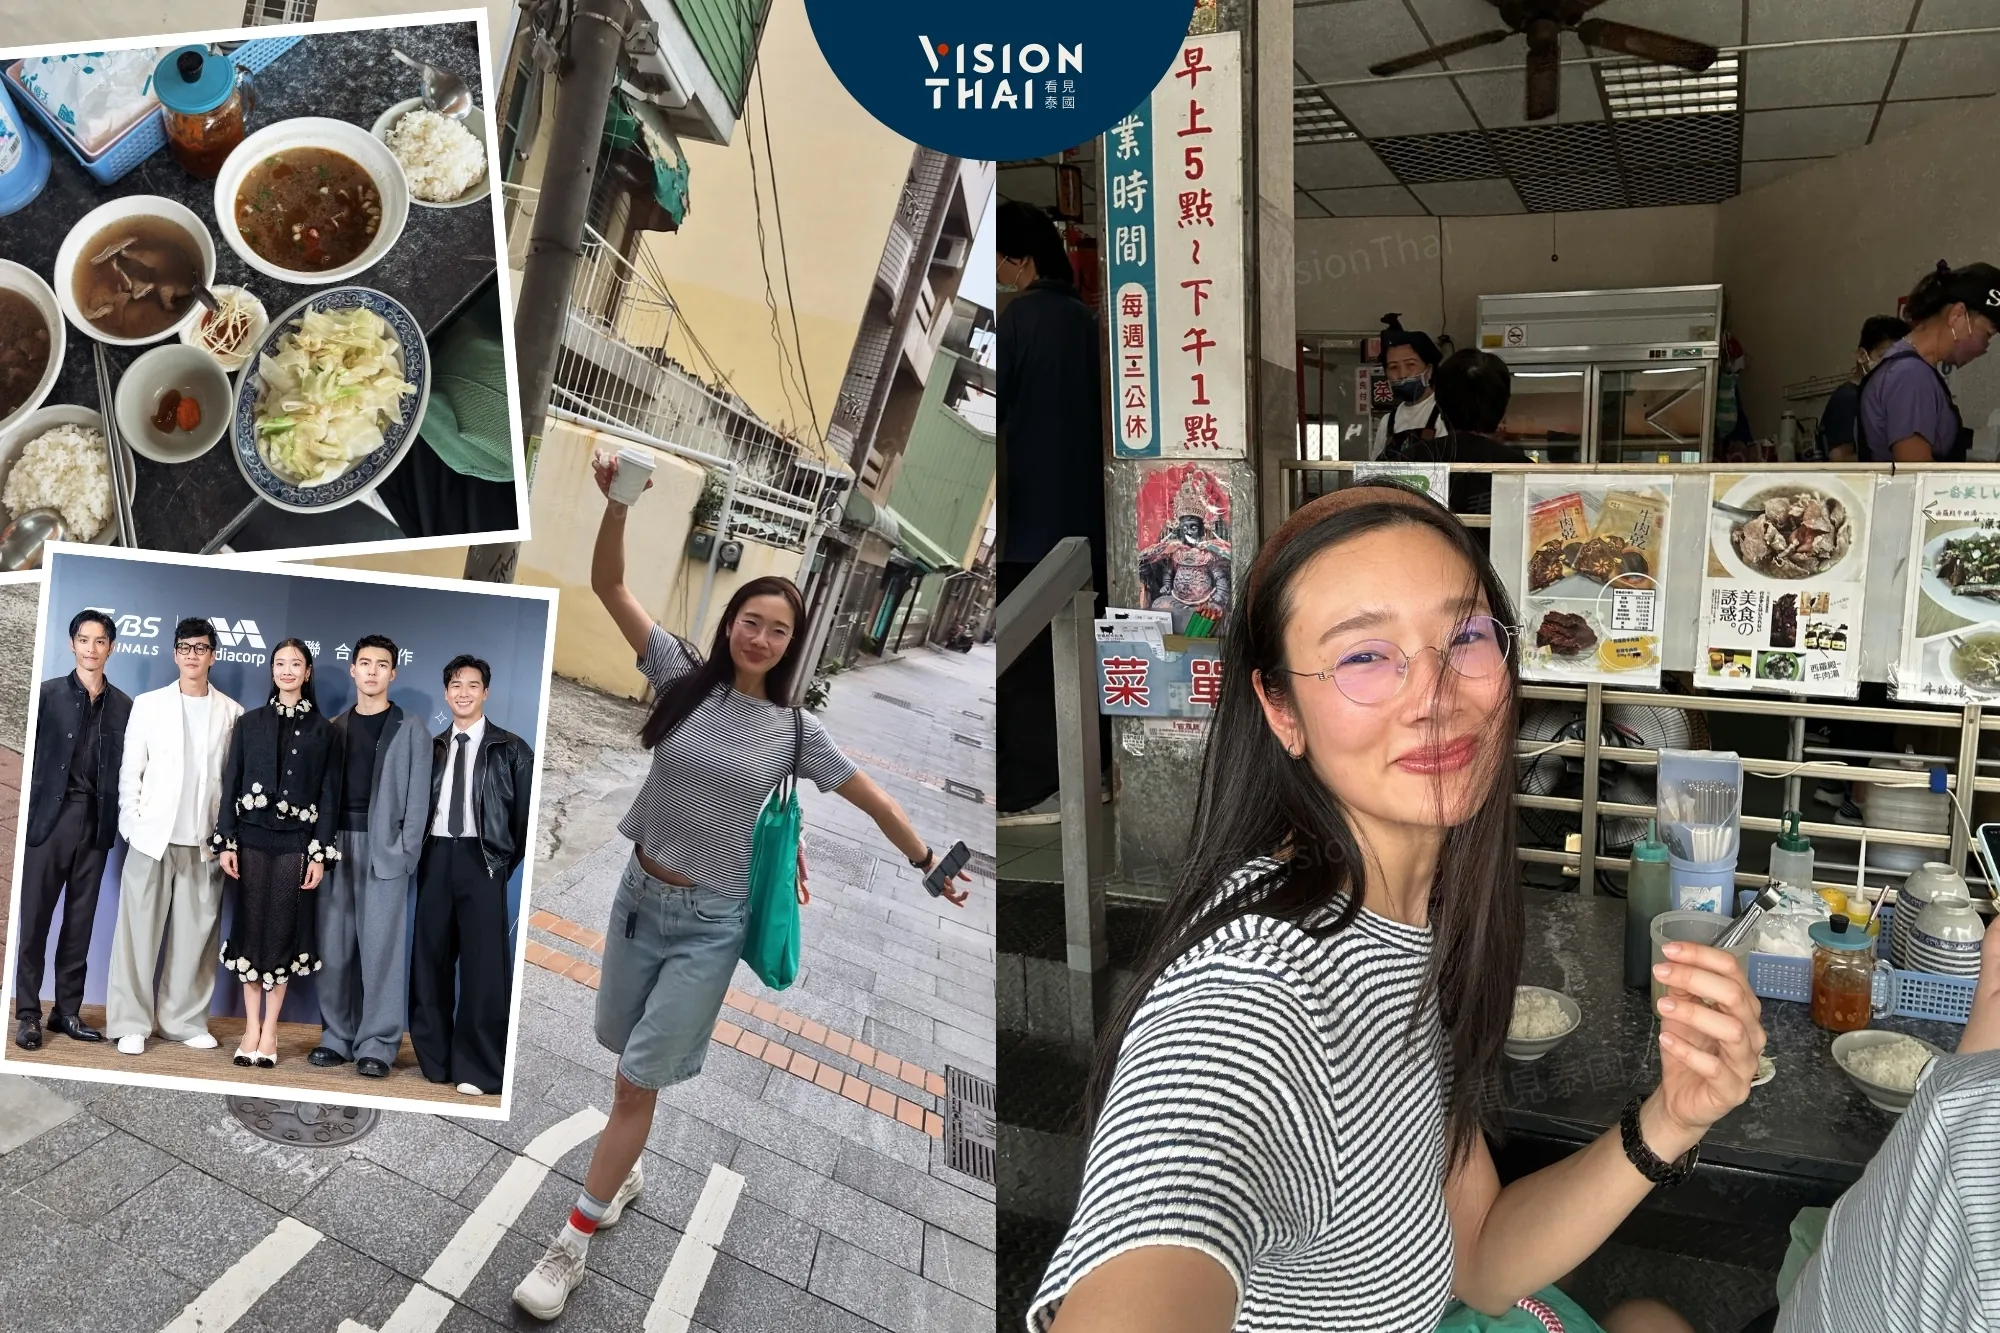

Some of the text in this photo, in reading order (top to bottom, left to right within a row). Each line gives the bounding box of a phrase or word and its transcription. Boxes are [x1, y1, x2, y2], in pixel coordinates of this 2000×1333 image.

[1738, 589, 1756, 636] 美食の
[114, 642, 160, 656] INALS
[215, 647, 266, 667] diacorp
